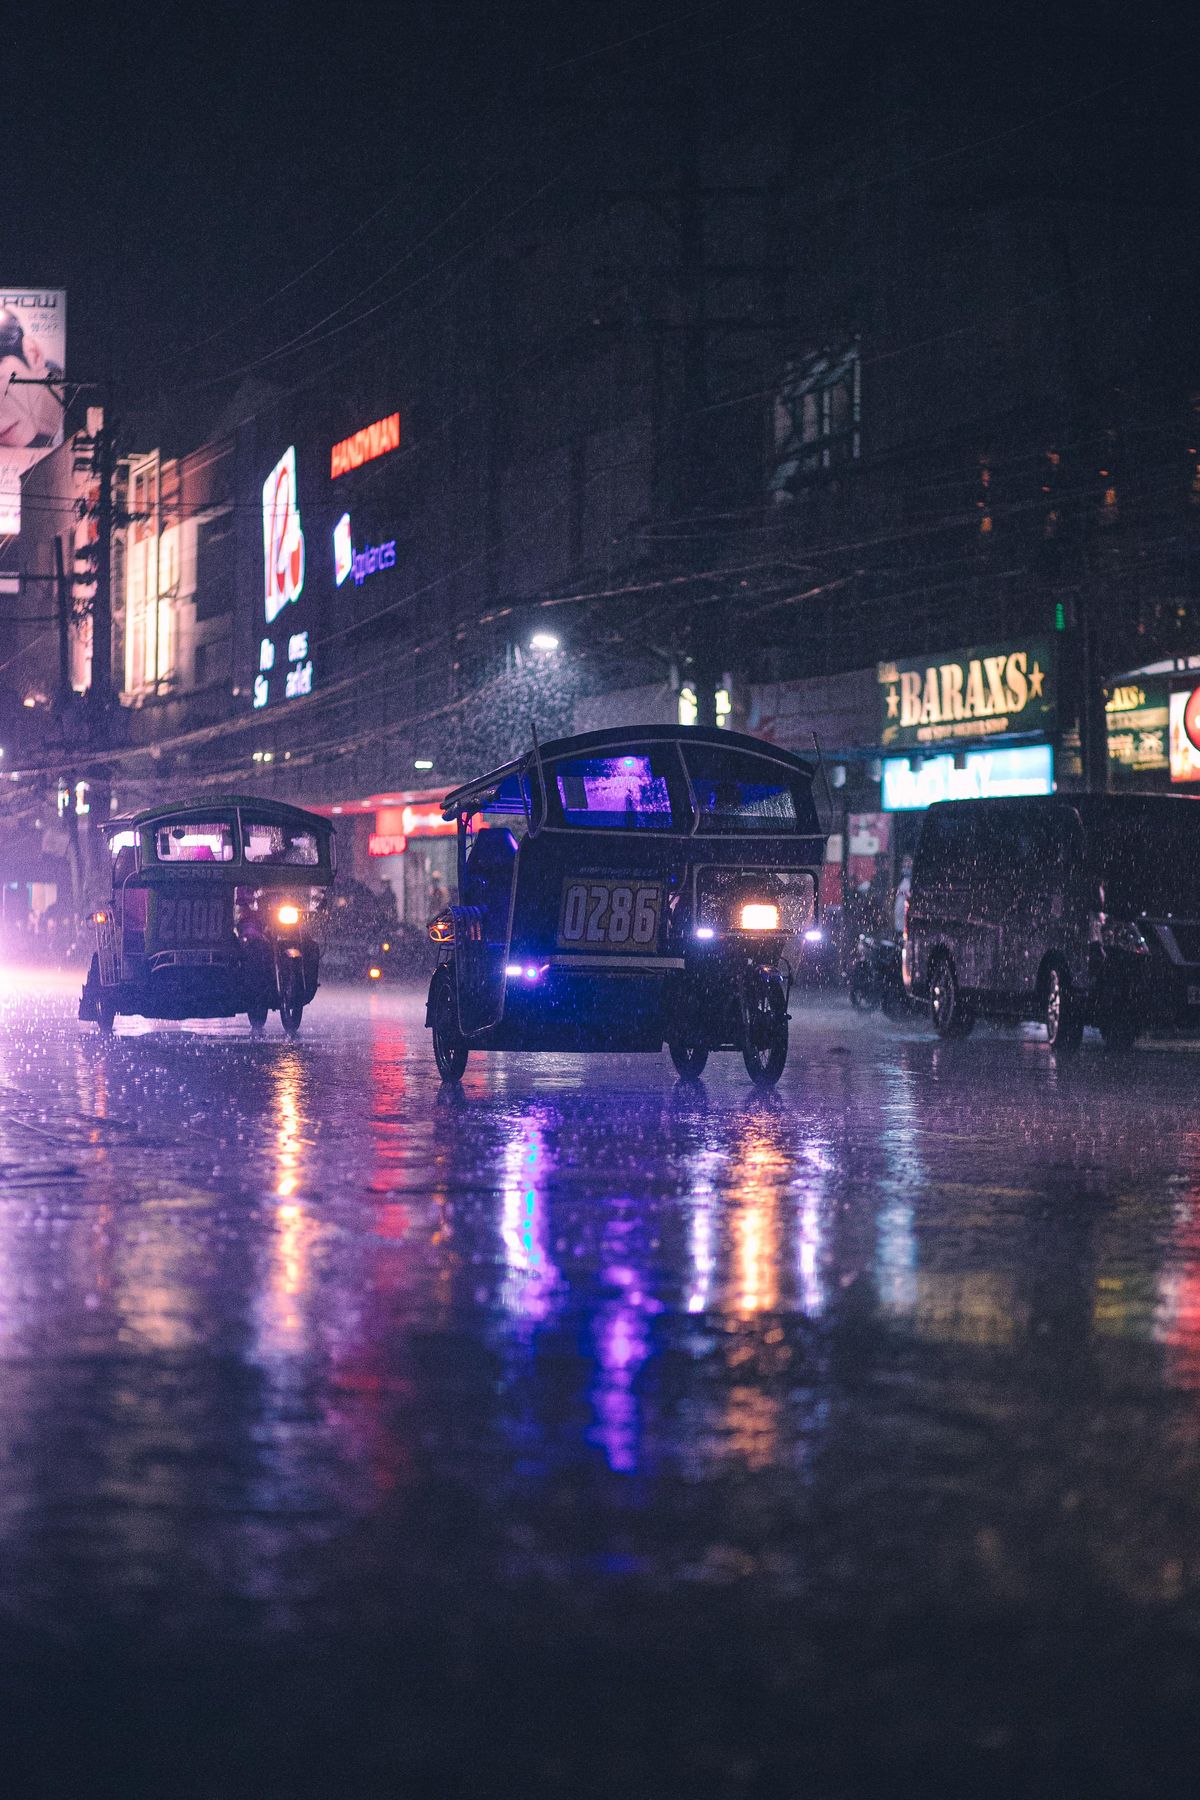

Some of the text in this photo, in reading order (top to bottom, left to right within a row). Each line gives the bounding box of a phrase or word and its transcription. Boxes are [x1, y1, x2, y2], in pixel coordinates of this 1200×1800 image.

[330, 411, 400, 481] HANDYMAN
[900, 652, 1028, 727] BARAXS
[562, 883, 660, 945] 0286
